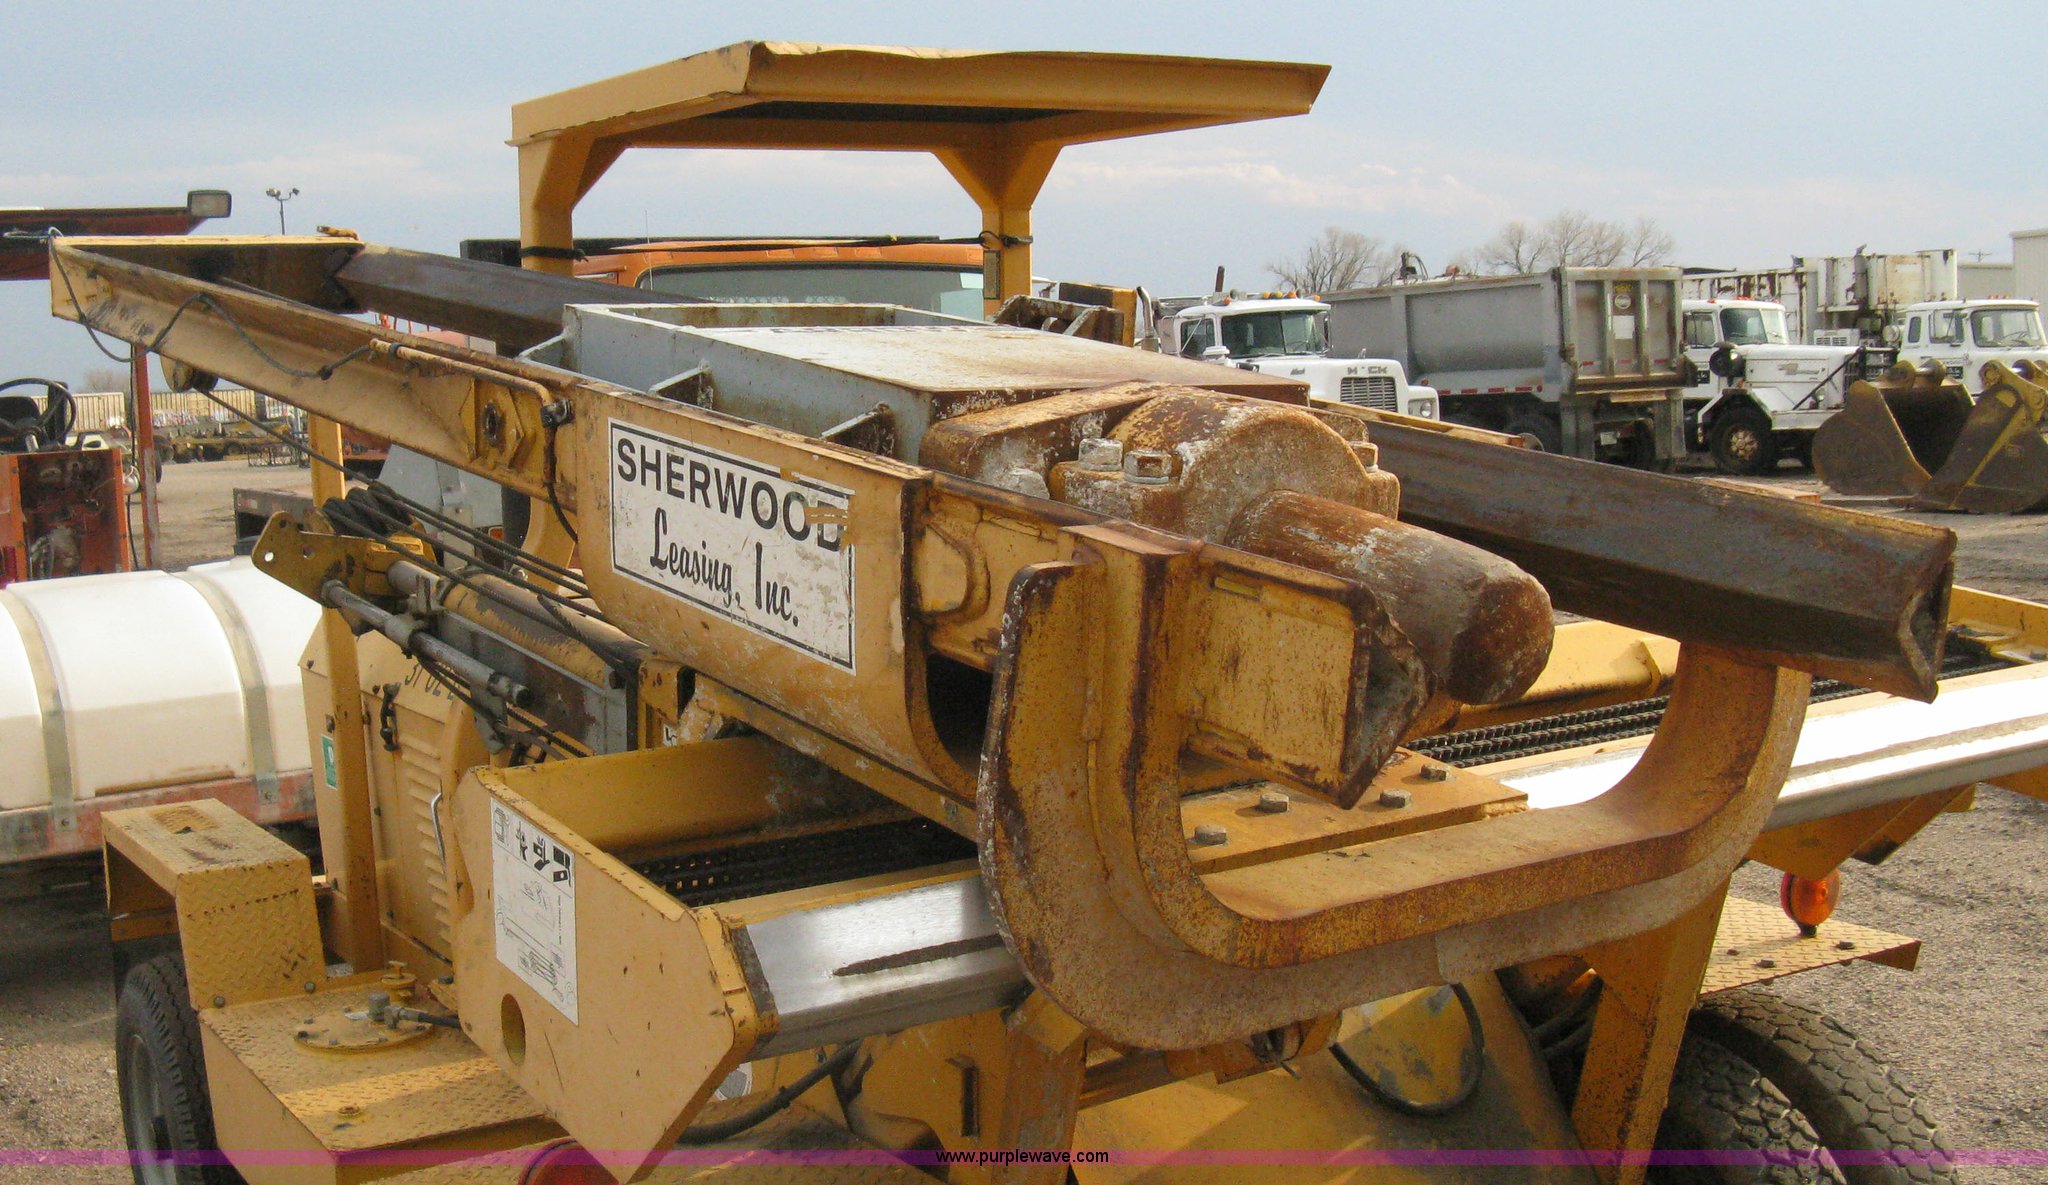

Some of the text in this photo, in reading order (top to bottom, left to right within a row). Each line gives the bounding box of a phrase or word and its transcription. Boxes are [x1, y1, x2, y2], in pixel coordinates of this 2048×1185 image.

[1346, 366, 1388, 375] MCK
[650, 507, 799, 627] Leasing, Inc.
